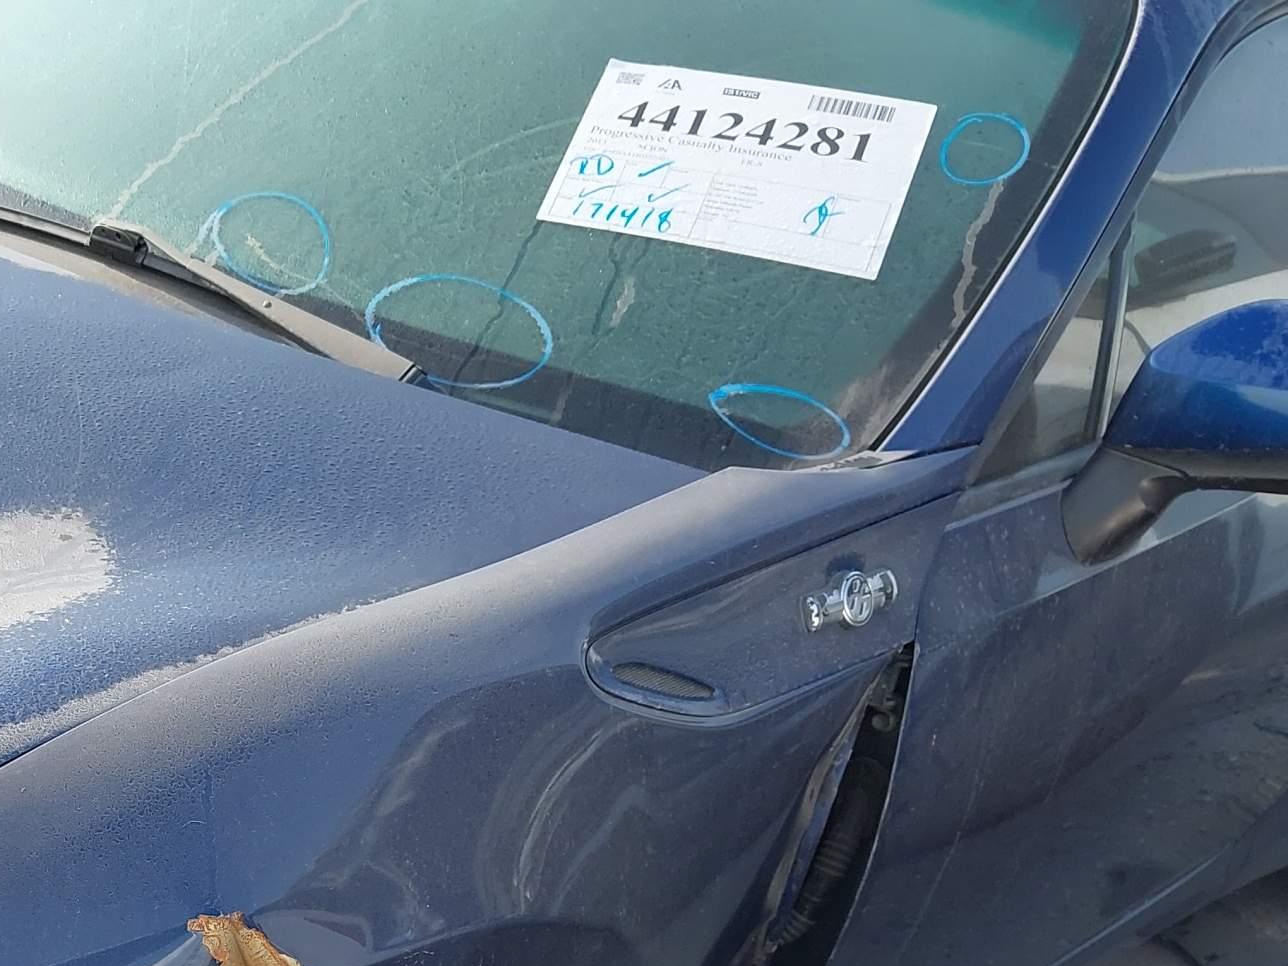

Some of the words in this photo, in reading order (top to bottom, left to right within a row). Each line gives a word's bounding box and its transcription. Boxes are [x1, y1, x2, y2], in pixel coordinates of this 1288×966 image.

[591, 125, 664, 143] Progressive
[668, 135, 722, 153] Casualty
[729, 144, 793, 161] Insurance
[617, 101, 872, 163] 44124281
